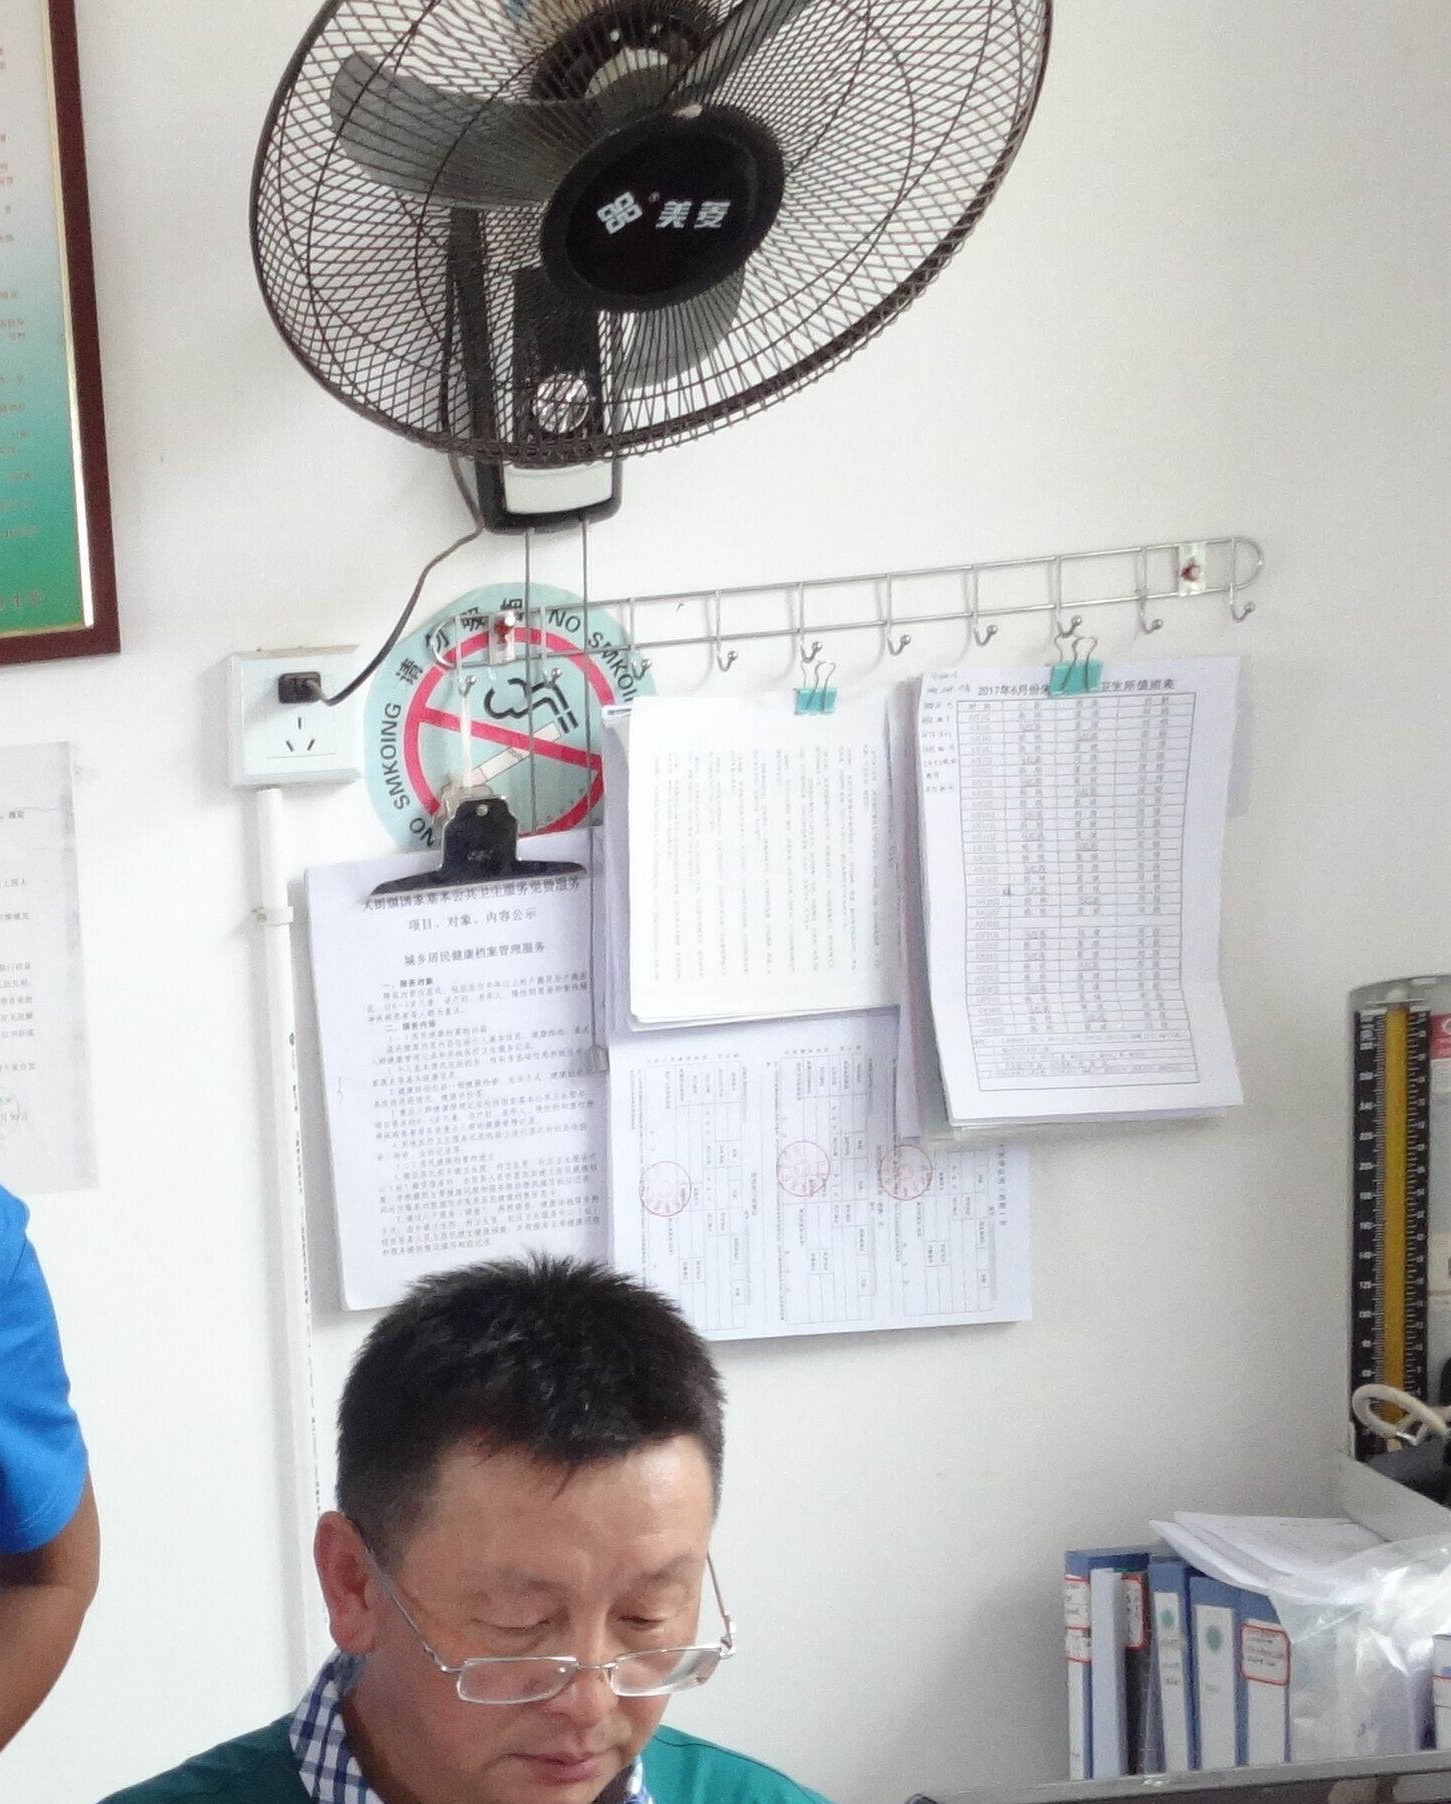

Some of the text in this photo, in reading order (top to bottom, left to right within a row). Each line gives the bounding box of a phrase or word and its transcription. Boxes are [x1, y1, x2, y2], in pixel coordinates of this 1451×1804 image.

[548, 608, 641, 702] NO SMKOI
[379, 702, 436, 847] NO SMKOING
[403, 940, 545, 966] 城乡居民健康档案管理服务
